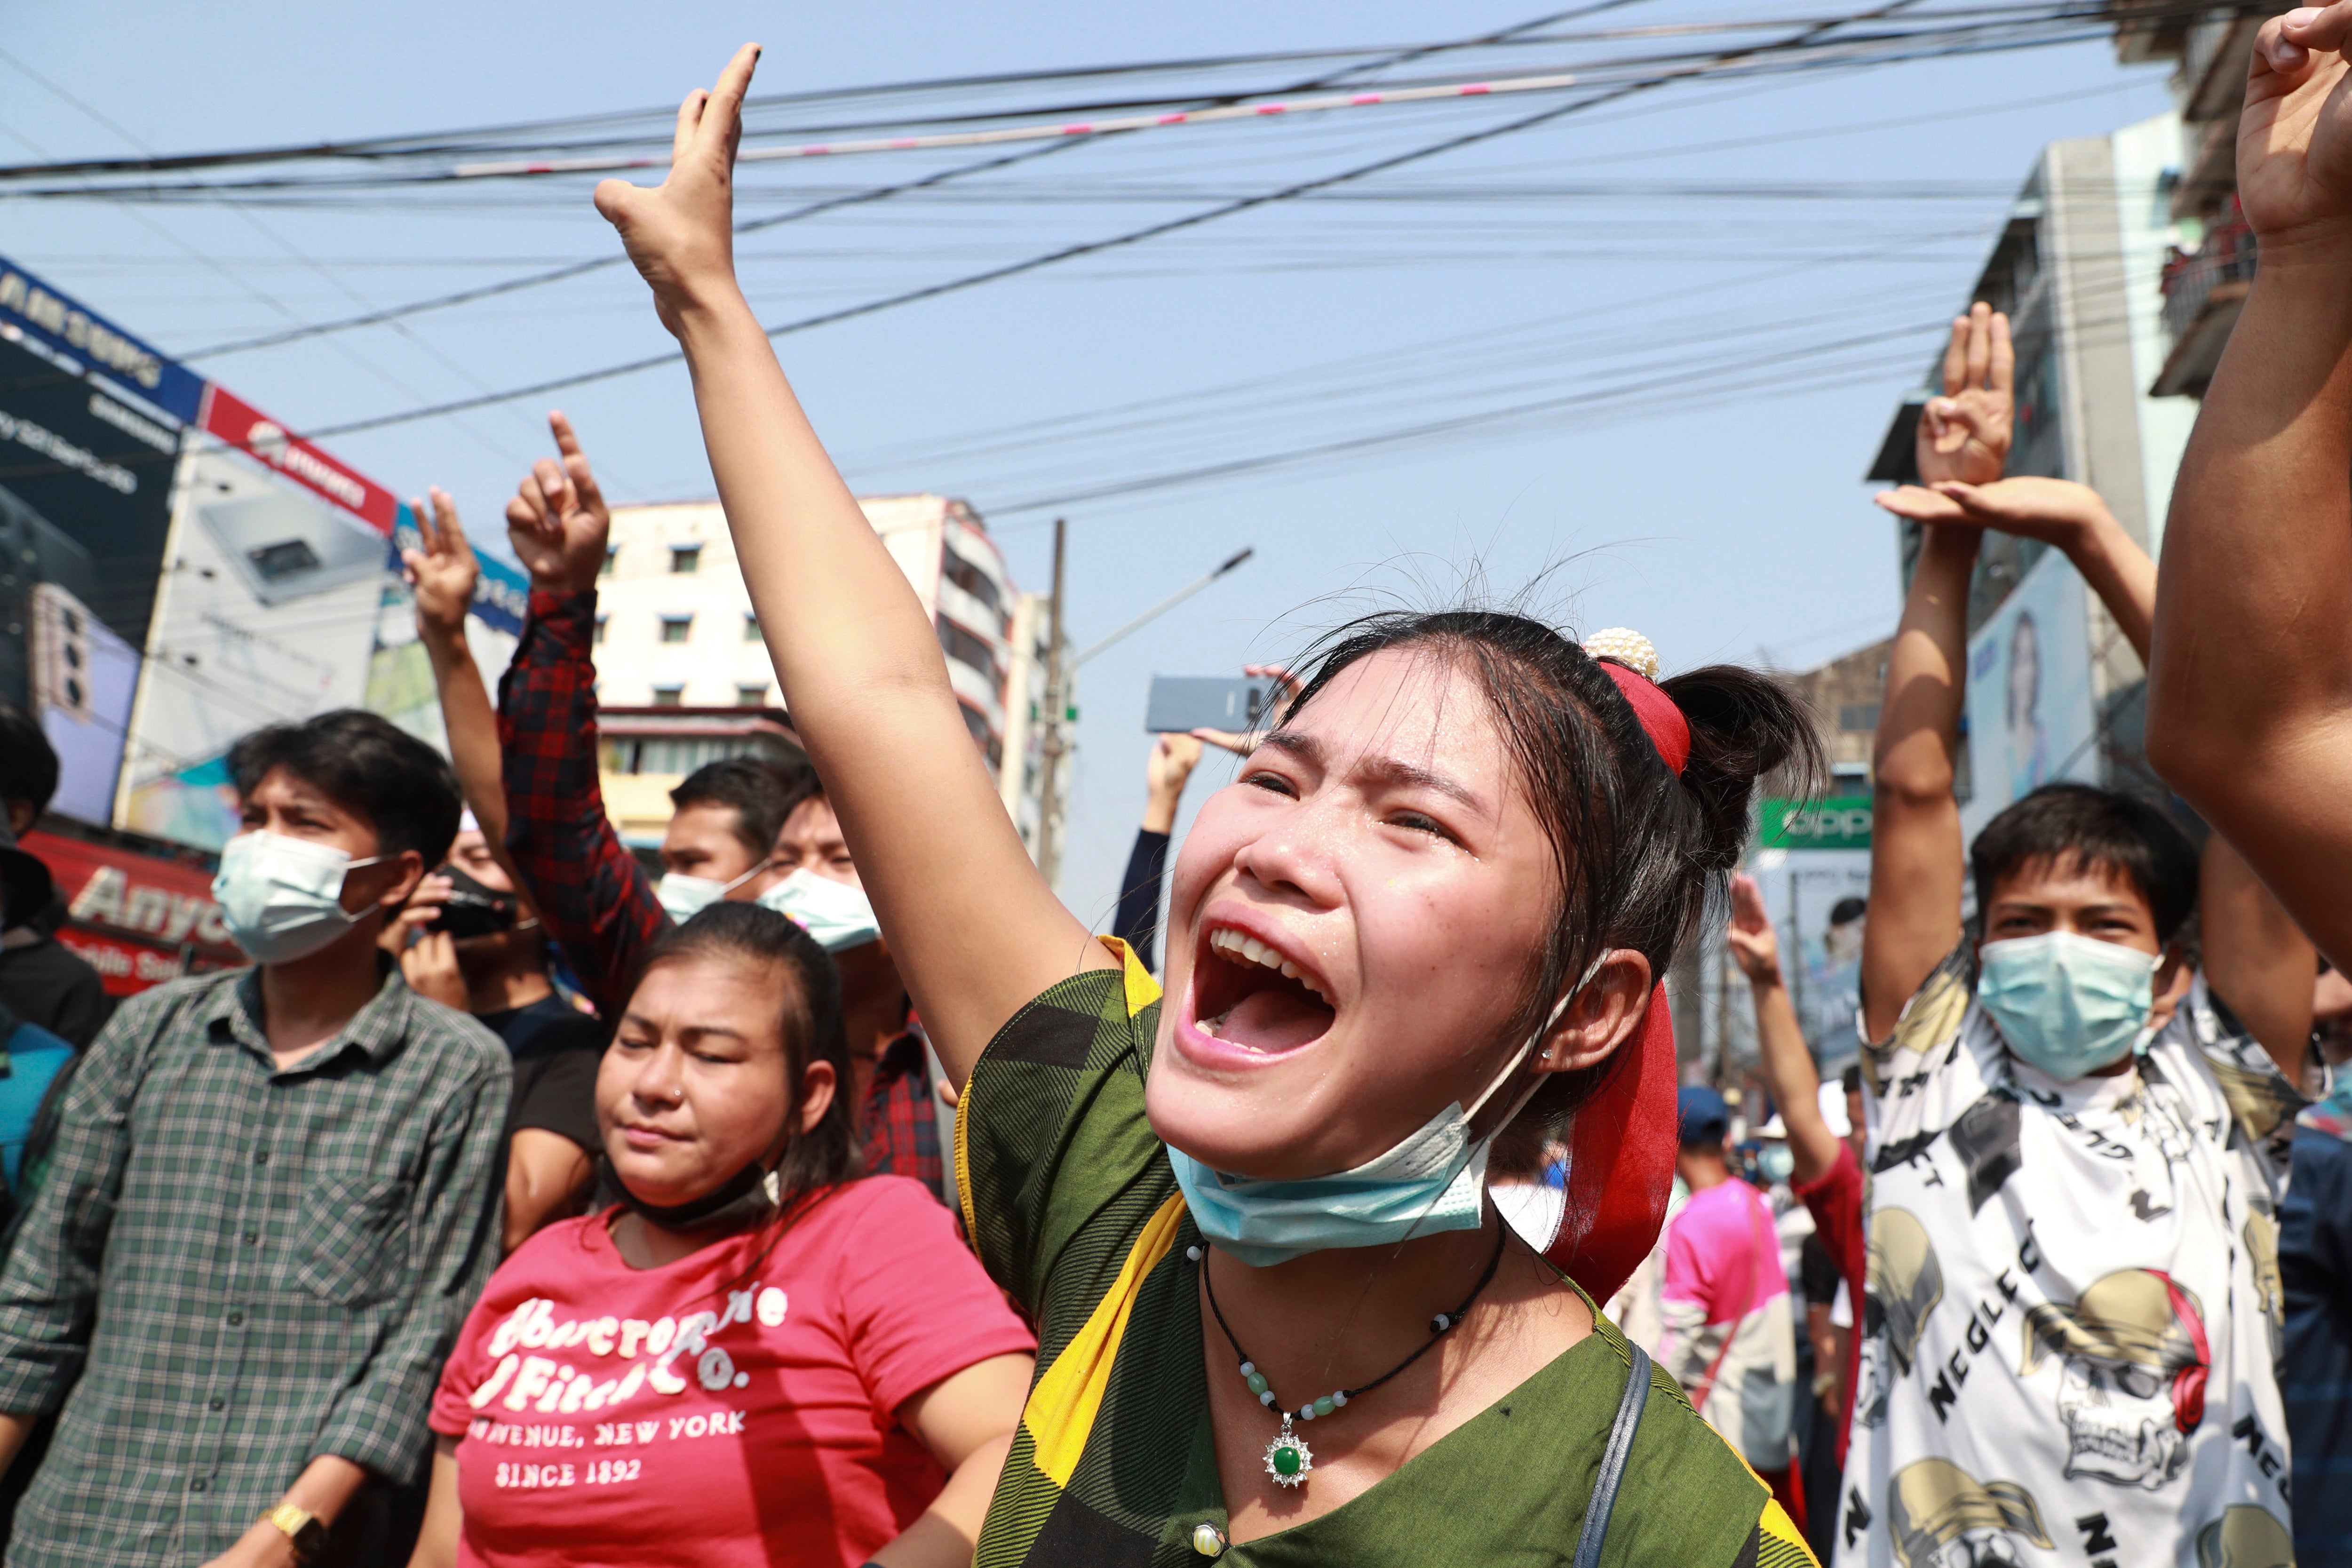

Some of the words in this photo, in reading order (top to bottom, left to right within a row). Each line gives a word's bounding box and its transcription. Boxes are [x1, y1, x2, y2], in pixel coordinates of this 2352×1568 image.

[0, 271, 162, 389] AMSUNG
[1929, 1218, 2039, 1429] NEGLEC
[594, 1420, 660, 1445] NEW
[669, 1410, 746, 1440] YORK
[495, 1462, 576, 1488] SINCE
[585, 1458, 642, 1485] 1892
